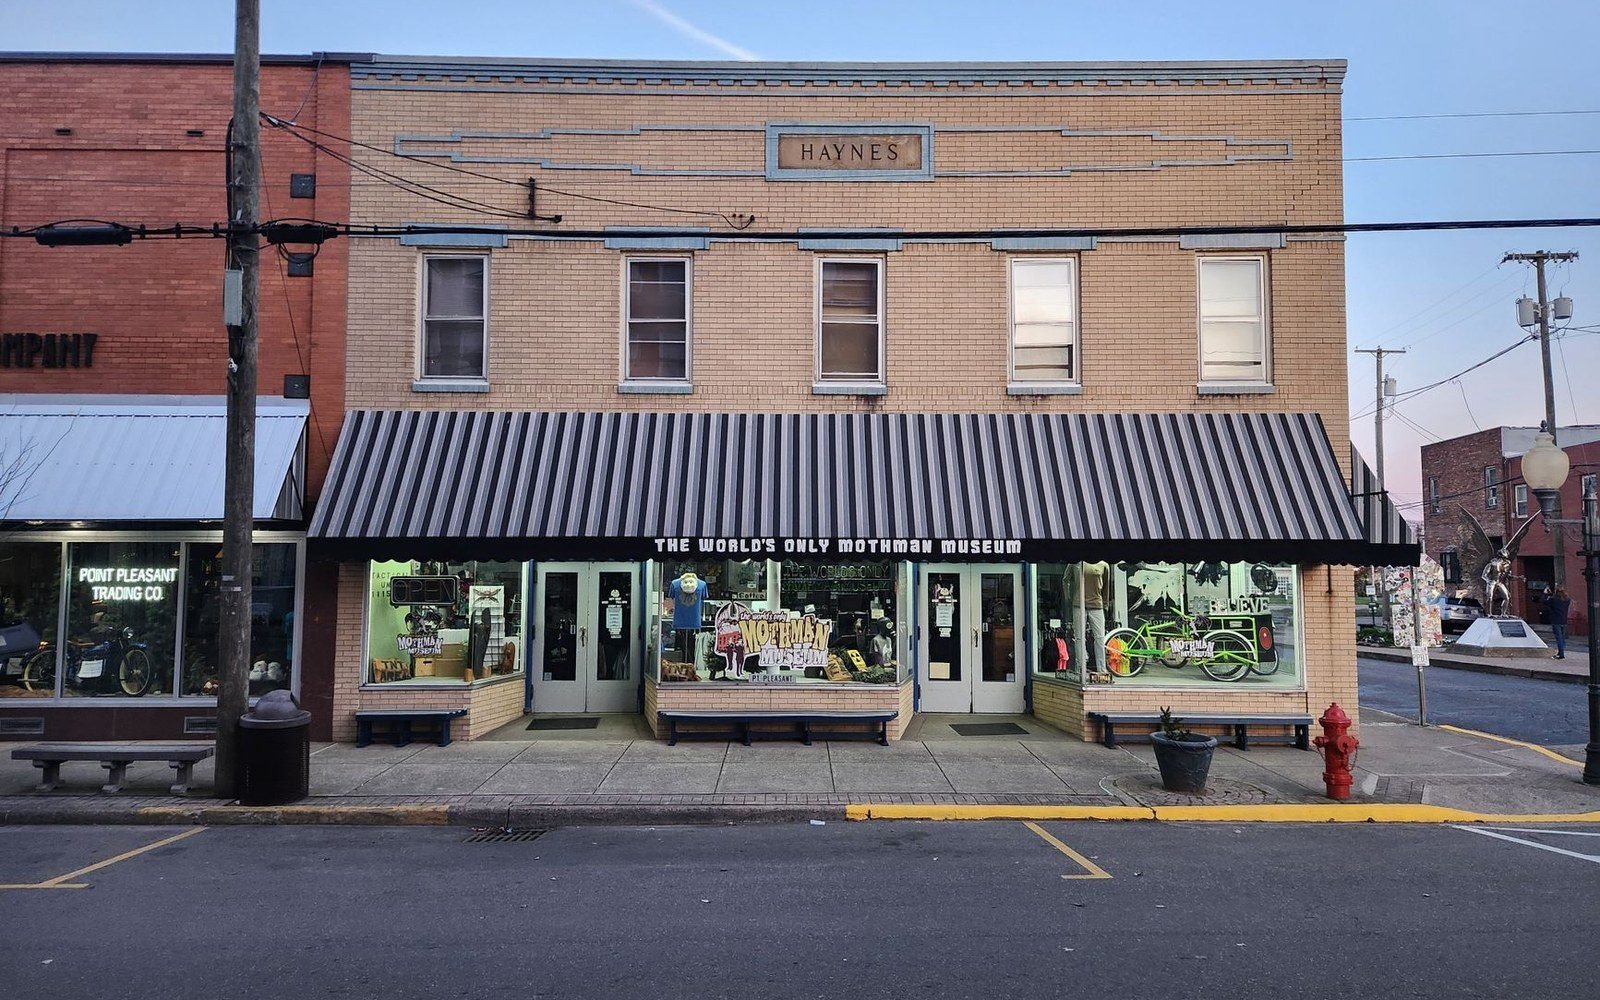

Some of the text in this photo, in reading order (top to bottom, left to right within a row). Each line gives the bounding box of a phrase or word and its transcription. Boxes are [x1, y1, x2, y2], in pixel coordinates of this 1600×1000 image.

[801, 143, 898, 161] HAYNES
[0, 332, 98, 368] MPANY
[655, 538, 1022, 554] THE WORLD'S ONLY MOTHMAN MUSEUM
[79, 568, 179, 582] POINT PLEASANT
[92, 586, 164, 600] TRADING CO.
[394, 580, 453, 602] OPEN
[738, 616, 830, 653] MOTHMAN
[397, 635, 443, 651] MOTHMAN
[1169, 638, 1215, 654] MOTHMAN
[761, 643, 828, 665] MUSEUM
[381, 661, 403, 670] TNT
